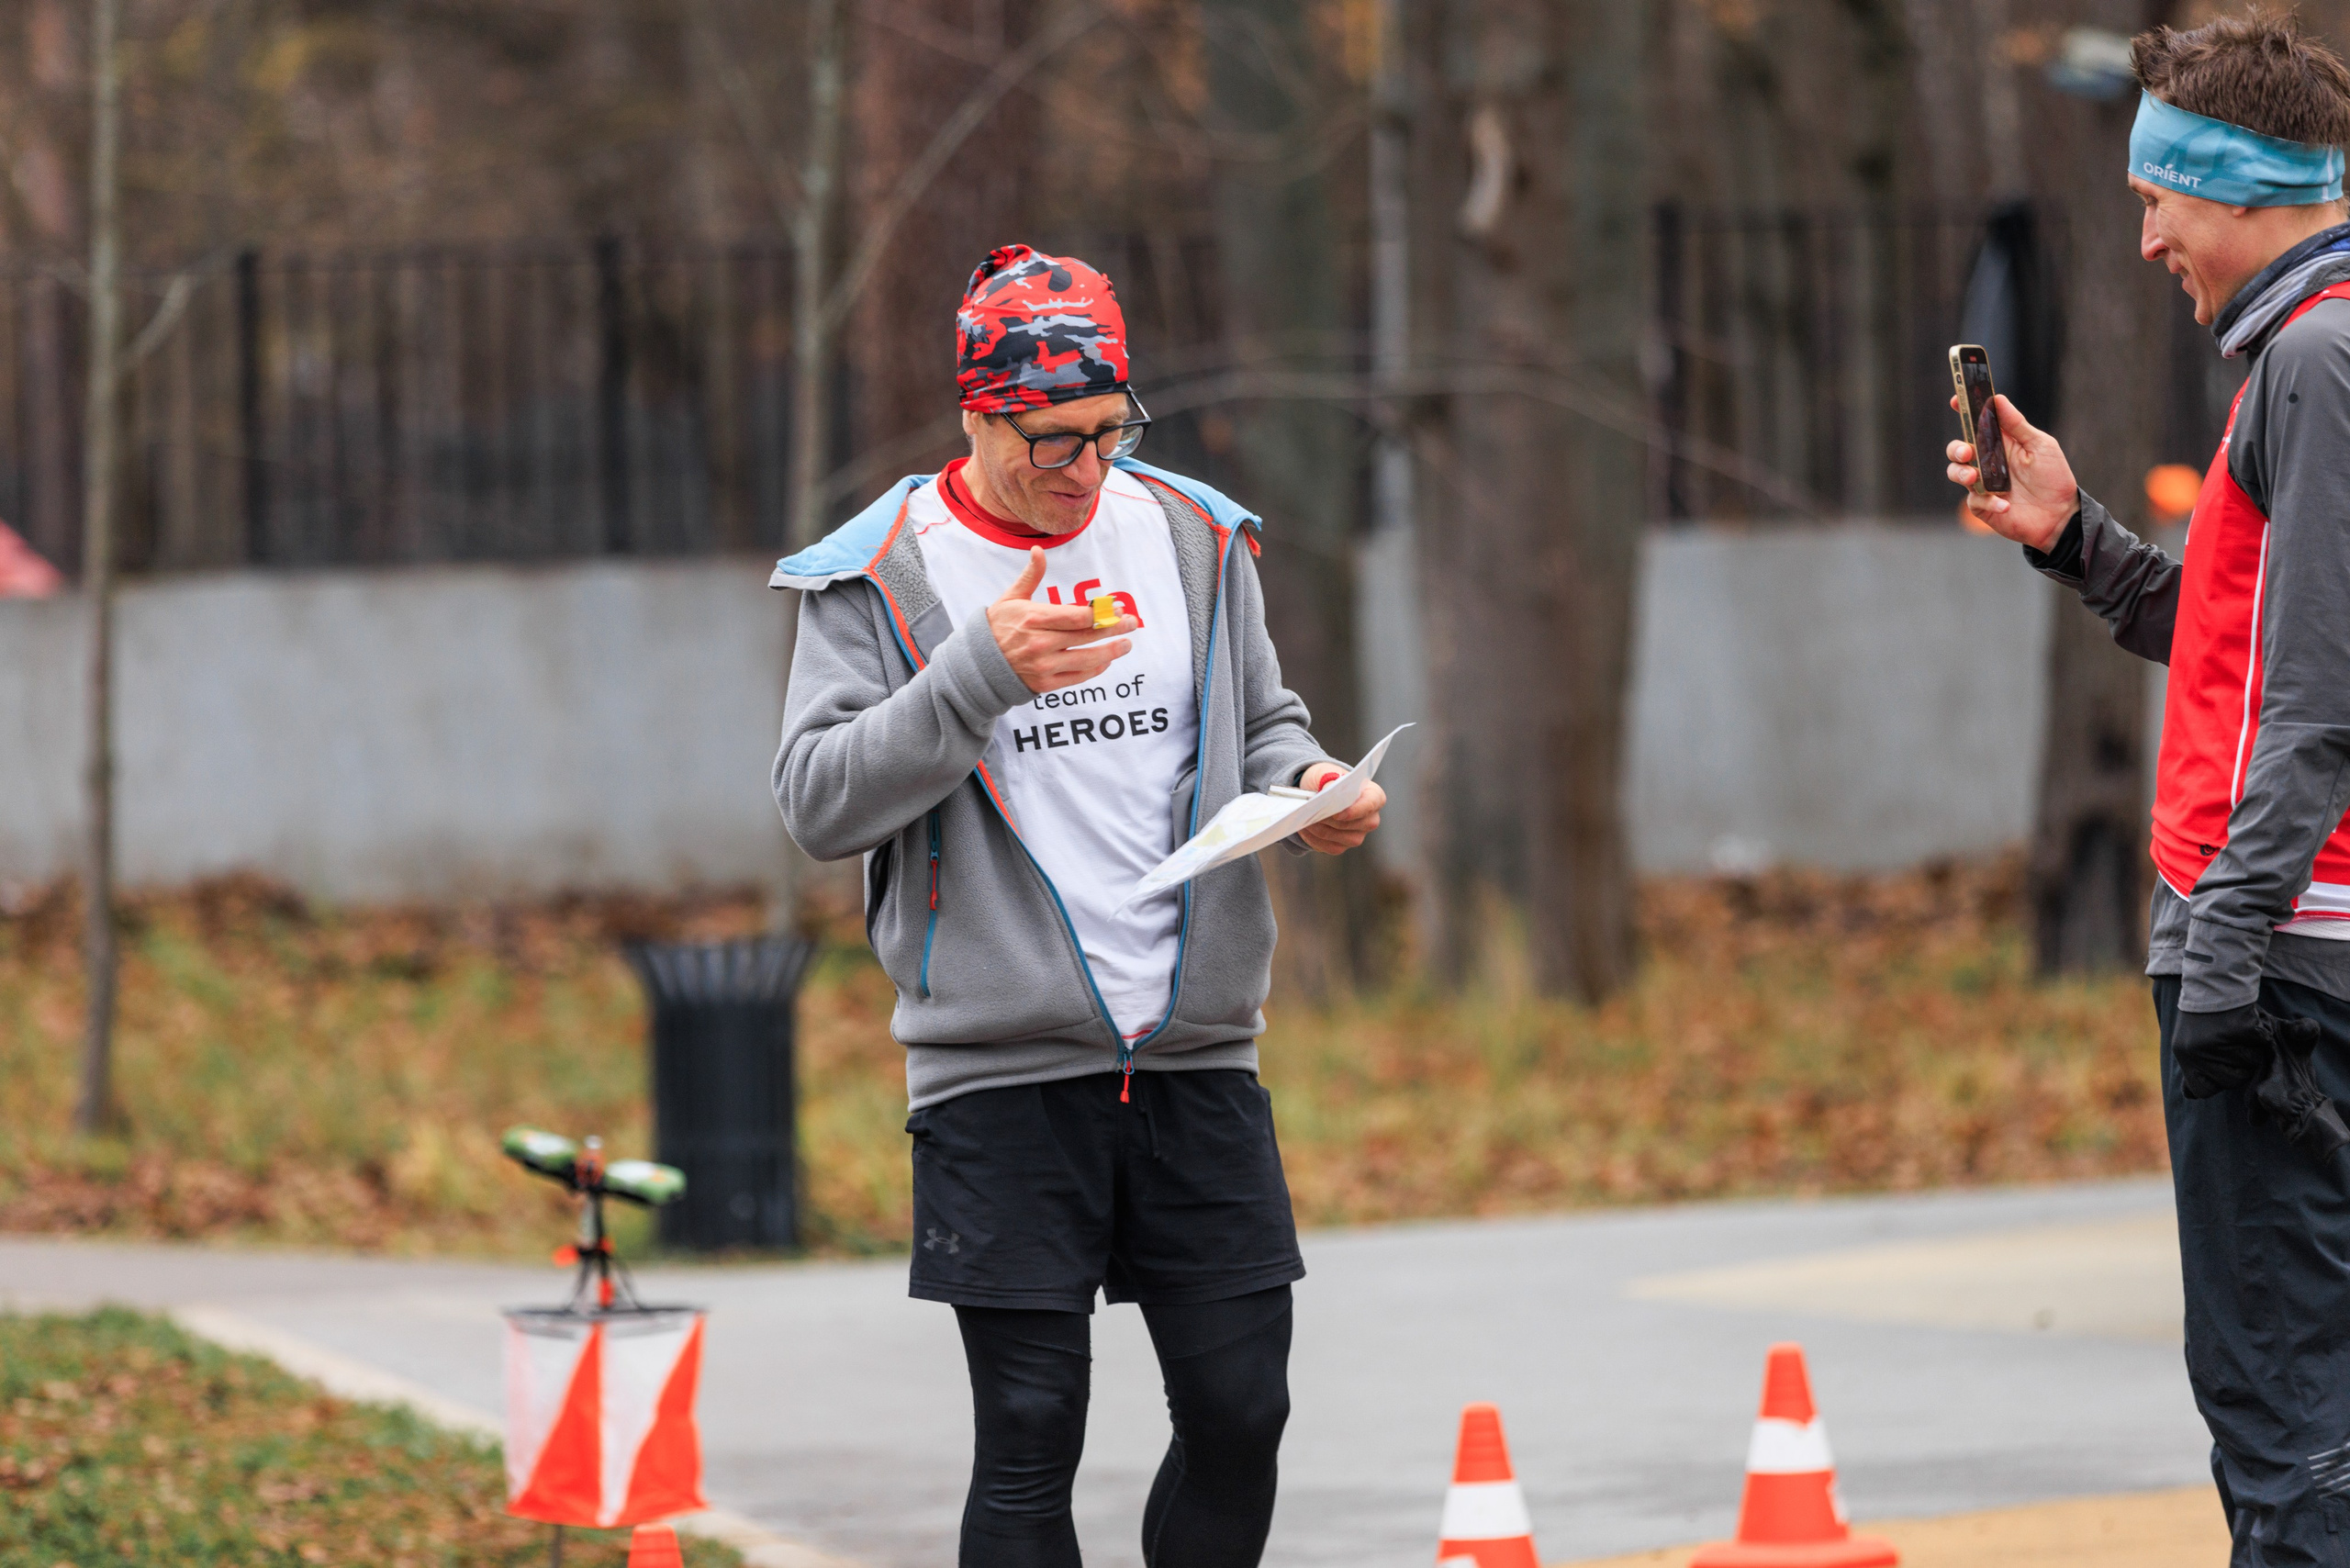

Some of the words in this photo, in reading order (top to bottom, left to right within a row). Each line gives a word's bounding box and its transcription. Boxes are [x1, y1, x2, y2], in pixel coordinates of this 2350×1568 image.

[2143, 162, 2202, 188] ORIENT
[1034, 686, 1107, 711] team
[1115, 674, 1146, 699] of
[1013, 707, 1169, 753] HEROES
